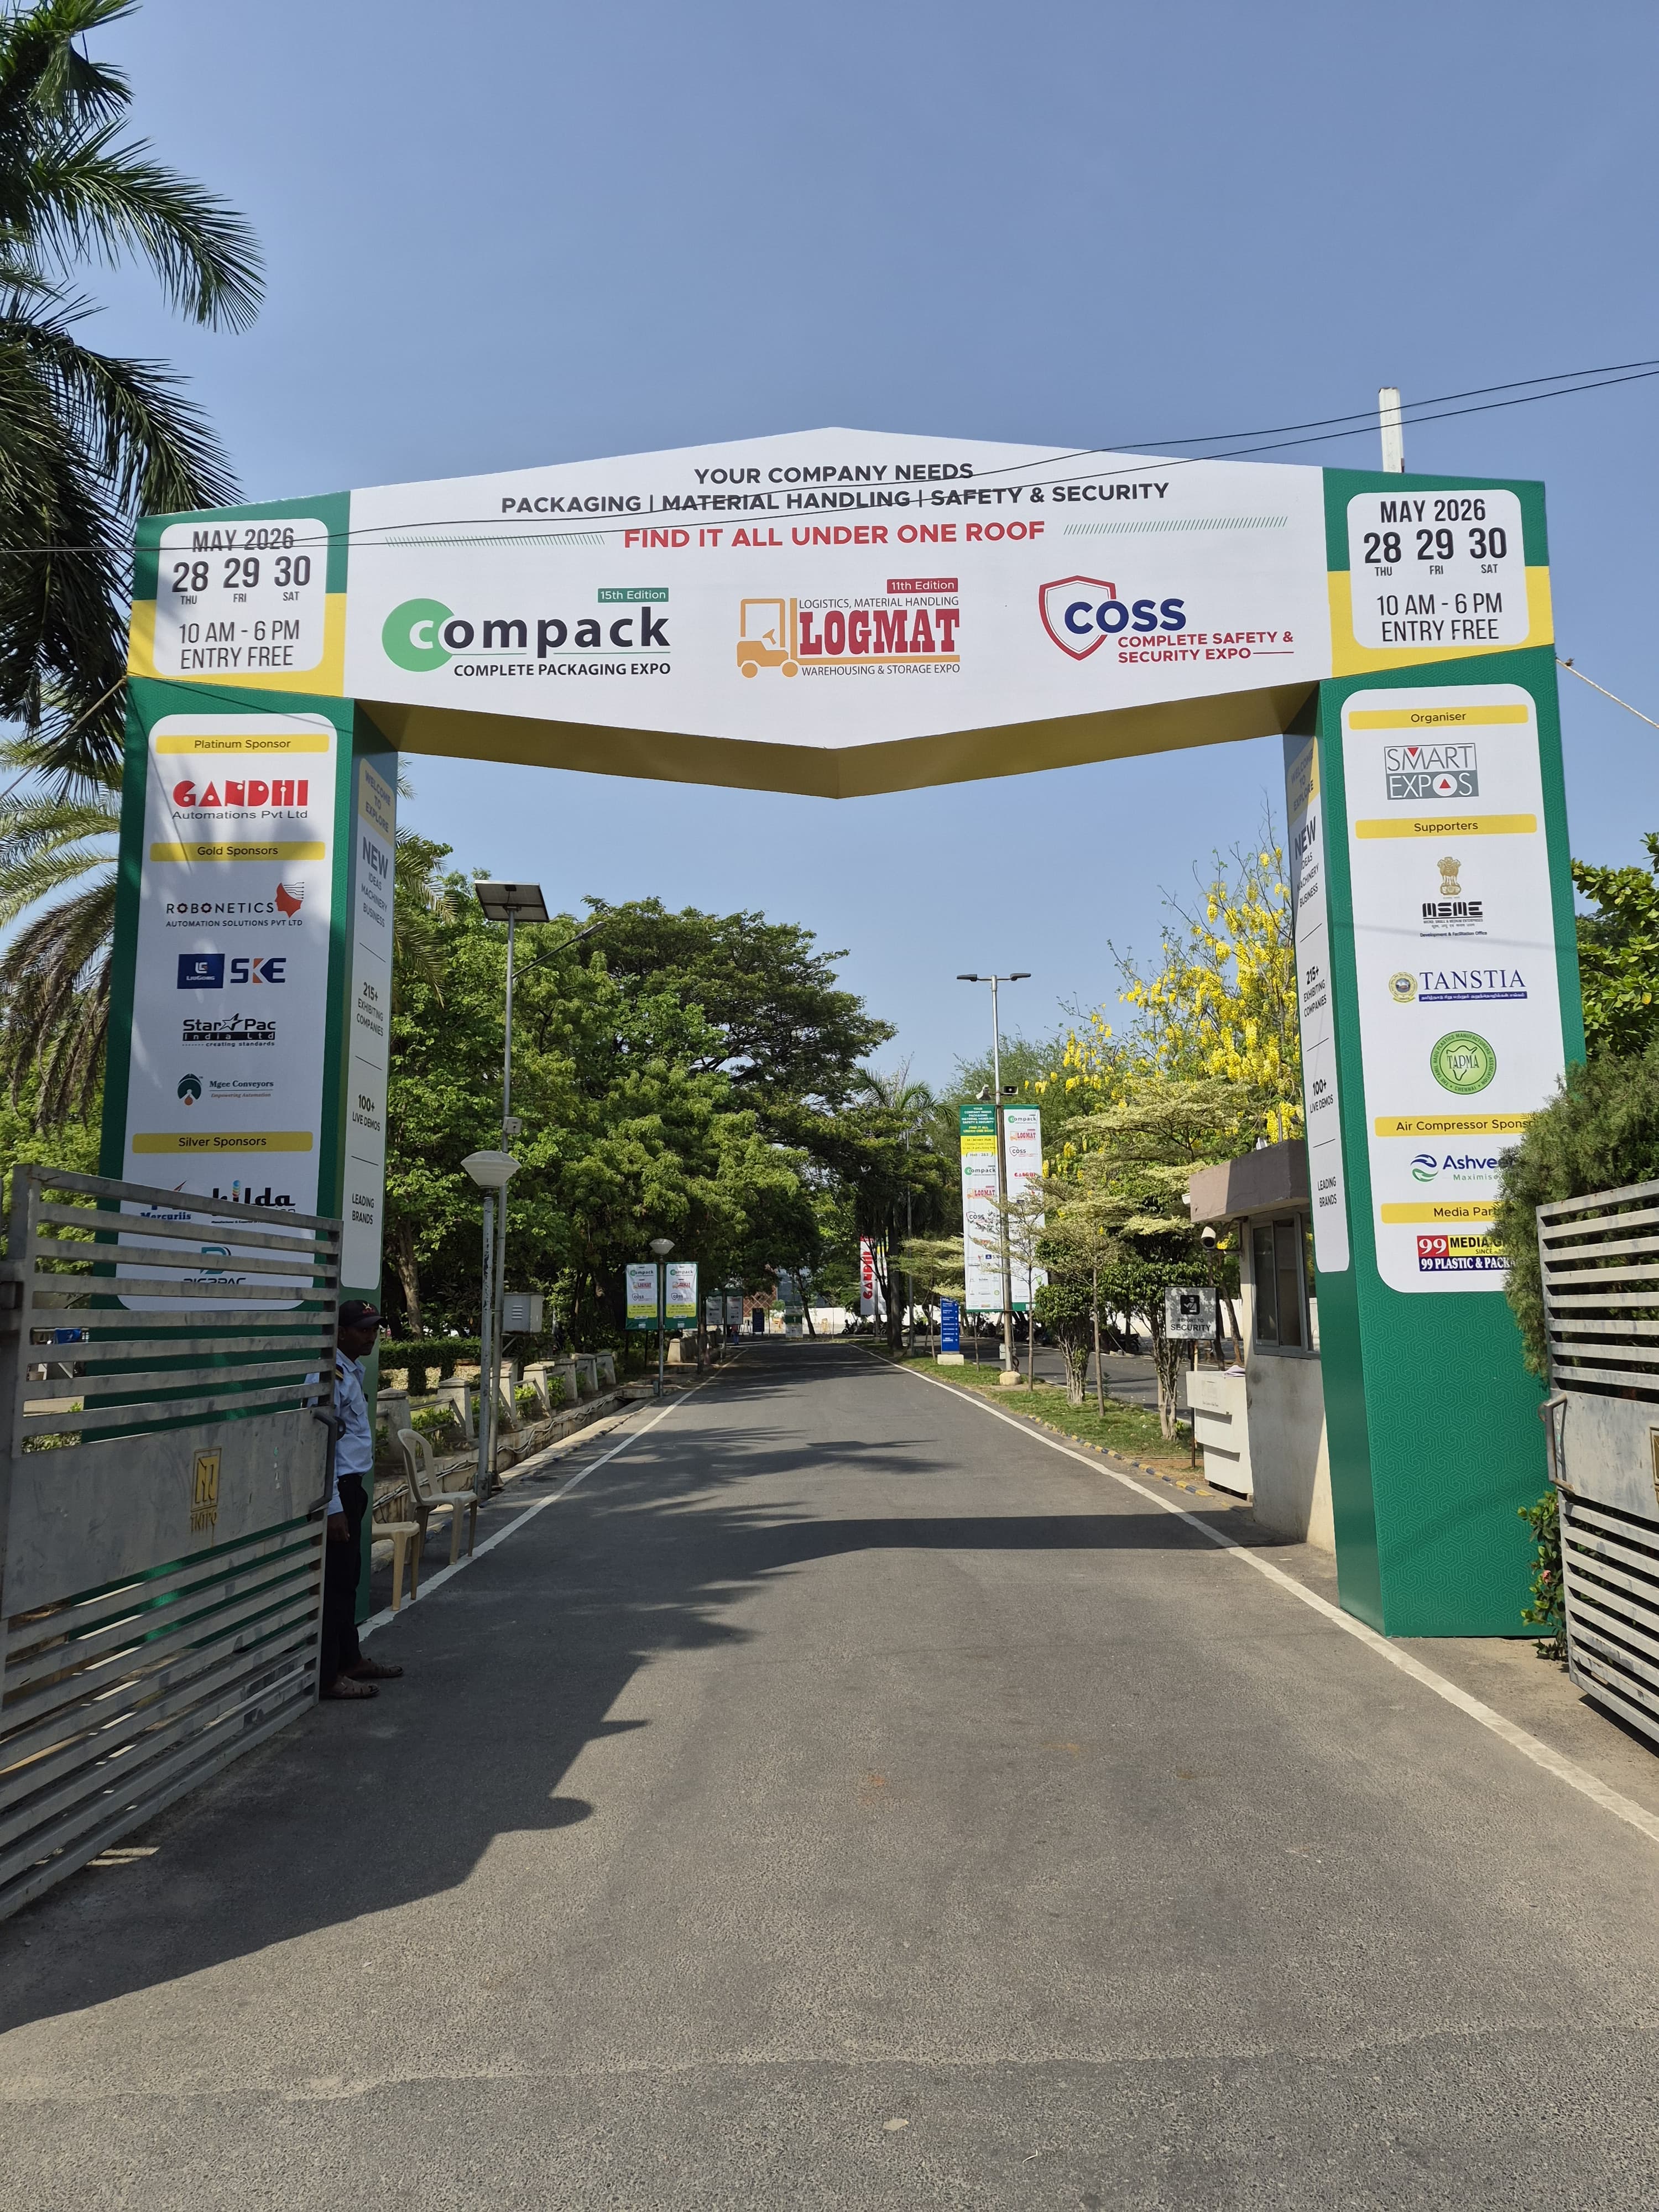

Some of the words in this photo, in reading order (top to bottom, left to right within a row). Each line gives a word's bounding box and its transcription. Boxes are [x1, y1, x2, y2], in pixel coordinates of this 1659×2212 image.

[695, 468, 761, 484] YOUR
[768, 465, 888, 483] COMPANY
[895, 463, 974, 481] NEEDS
[501, 495, 641, 514] PACKAGING
[662, 492, 779, 512] MATERIAL
[786, 491, 910, 509] HANDLING
[931, 487, 1022, 507] SAFETY
[1030, 486, 1045, 503] &
[1052, 482, 1170, 502] SECURITY
[1380, 499, 1426, 523] MAY
[1434, 498, 1486, 522] 2026
[192, 529, 236, 552] MAY
[244, 527, 294, 549] 2026
[624, 529, 690, 548] FIND
[700, 528, 724, 547] IT
[732, 526, 782, 546] ALL
[791, 525, 888, 546] UNDER
[897, 523, 957, 544] ONE
[966, 520, 1045, 542] ROOF
[1364, 531, 1401, 564] 28
[1416, 528, 1454, 560] 29
[1469, 527, 1507, 559] 30
[172, 561, 208, 593] 28
[223, 557, 259, 588] 29
[274, 555, 311, 587] 30
[1375, 566, 1392, 576] THU
[1430, 565, 1443, 575] FRI
[1481, 564, 1498, 573] SAT
[891, 580, 912, 591] 11th
[916, 579, 954, 590] Edition
[181, 594, 197, 605] THU
[233, 593, 247, 603] FRI
[283, 591, 300, 601] SAT
[601, 590, 623, 601] 15th
[627, 589, 666, 601] Edition
[799, 598, 852, 610] LOGISTICS,
[855, 597, 904, 608] MATERIAL
[906, 596, 959, 607] HANDLING
[1376, 595, 1398, 615] 10
[1405, 594, 1435, 615] AM
[1455, 593, 1467, 613] 6
[1474, 592, 1503, 613] PM
[1064, 598, 1187, 635] COSS
[179, 623, 200, 644] 10
[205, 622, 234, 642] AM
[254, 620, 265, 641] 6
[272, 619, 300, 640] PM
[799, 608, 960, 655] LOGMAT
[1118, 633, 1208, 648] COMPLETE
[1212, 631, 1279, 646] SAFETY
[1282, 630, 1294, 644] &
[1382, 620, 1444, 642] ENTRY
[1452, 619, 1499, 640] FREE
[181, 646, 242, 669] ENTRY
[248, 645, 293, 667] FREE
[1118, 648, 1200, 664] SECURITY
[1205, 646, 1251, 660] EXPO
[454, 664, 535, 677] COMPLETE
[539, 663, 627, 676] PACKAGING
[631, 662, 671, 676] EXPO
[802, 665, 876, 676] WAREHOUSING
[878, 665, 885, 675] &
[887, 664, 932, 675] STORAGE
[933, 662, 961, 674] EXPO
[1411, 711, 1467, 724] Organiser
[194, 739, 242, 749] Platinum
[246, 739, 291, 750] Sponsor
[1291, 749, 1313, 782] WELCOME
[1386, 745, 1473, 772] SMART
[173, 780, 309, 807] GANDHI
[365, 770, 391, 806] WELCOME
[1293, 779, 1314, 812] EXPLORE
[1389, 772, 1473, 800] EXPOS
[374, 795, 382, 810] TO
[172, 810, 257, 820] Automations
[261, 810, 283, 819] Pvt
[287, 810, 308, 818] Ltd
[366, 801, 389, 833] EXPLORE
[1414, 821, 1478, 834] Supporters
[1294, 816, 1316, 860] NEW
[197, 846, 223, 855] Gold
[227, 846, 278, 857] Sponsors
[363, 836, 388, 879] NEW
[1301, 852, 1313, 872] IDEAS
[368, 872, 382, 891] IDEAS
[1297, 863, 1319, 894] MACHINERY
[361, 883, 388, 912] MACHINERY
[1300, 883, 1318, 908] BUSINESS
[166, 902, 274, 915] ROBONETICS
[363, 902, 385, 928] BUSINESS
[1422, 901, 1483, 917] MSME
[1306, 966, 1319, 985] 215+
[1419, 969, 1526, 990] TANSTIA
[363, 982, 378, 1001] 215+
[1303, 979, 1326, 1003] EXHIBITING
[358, 998, 383, 1021] EXHIBITING
[1303, 994, 1327, 1018] COMPANIES
[183, 1019, 221, 1032] Star
[244, 1019, 276, 1031] Pac
[357, 1013, 383, 1037] COMPANIES
[1447, 1054, 1480, 1069] TAPMA
[209, 1081, 231, 1089] Mgee
[232, 1080, 274, 1089] Conveyors
[1312, 1078, 1327, 1097] 100+
[358, 1094, 375, 1112] 100+
[1310, 1099, 1319, 1114] LIVE
[1319, 1094, 1333, 1111] DEMOS
[352, 1111, 363, 1126] LIVE
[364, 1114, 380, 1131] DEMOS
[1396, 1122, 1412, 1131] Air
[1416, 1120, 1488, 1132] Compressor
[1492, 1119, 1532, 1130] Spons
[178, 1136, 211, 1147] Silver
[213, 1136, 267, 1148] Sponsors
[1442, 1155, 1501, 1170] Ashve
[1317, 1176, 1337, 1191] LEADING
[352, 1193, 374, 1208] LEADING
[1319, 1193, 1337, 1208] BRANDS
[352, 1209, 373, 1225] BRANDS
[1434, 1207, 1469, 1217] Media
[1419, 1238, 1447, 1255] 99
[1450, 1237, 1489, 1248] MEDIA
[1421, 1258, 1433, 1269] 99
[1435, 1257, 1474, 1269] PLASTIC
[1475, 1257, 1483, 1269] &
